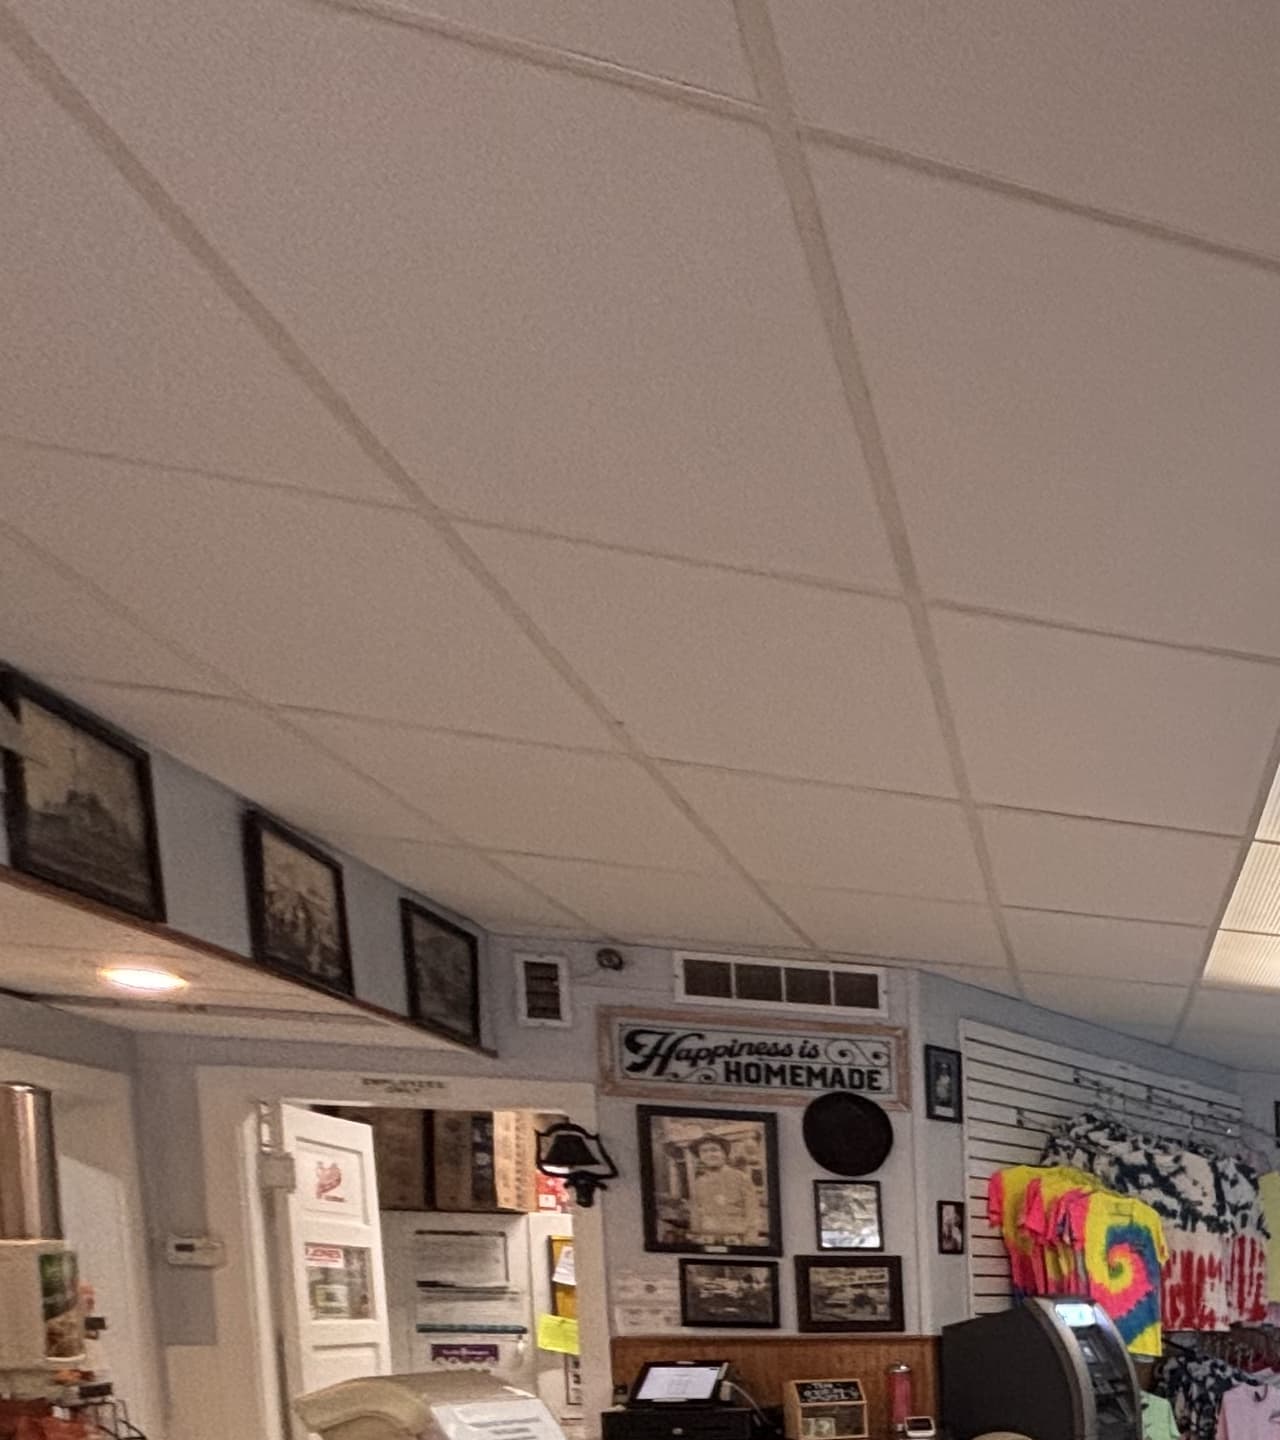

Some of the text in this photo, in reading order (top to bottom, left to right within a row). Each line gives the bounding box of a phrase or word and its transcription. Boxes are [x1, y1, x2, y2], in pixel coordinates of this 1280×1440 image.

[624, 1029, 821, 1077] Happiness is
[723, 1060, 883, 1091] HOMEMADE
